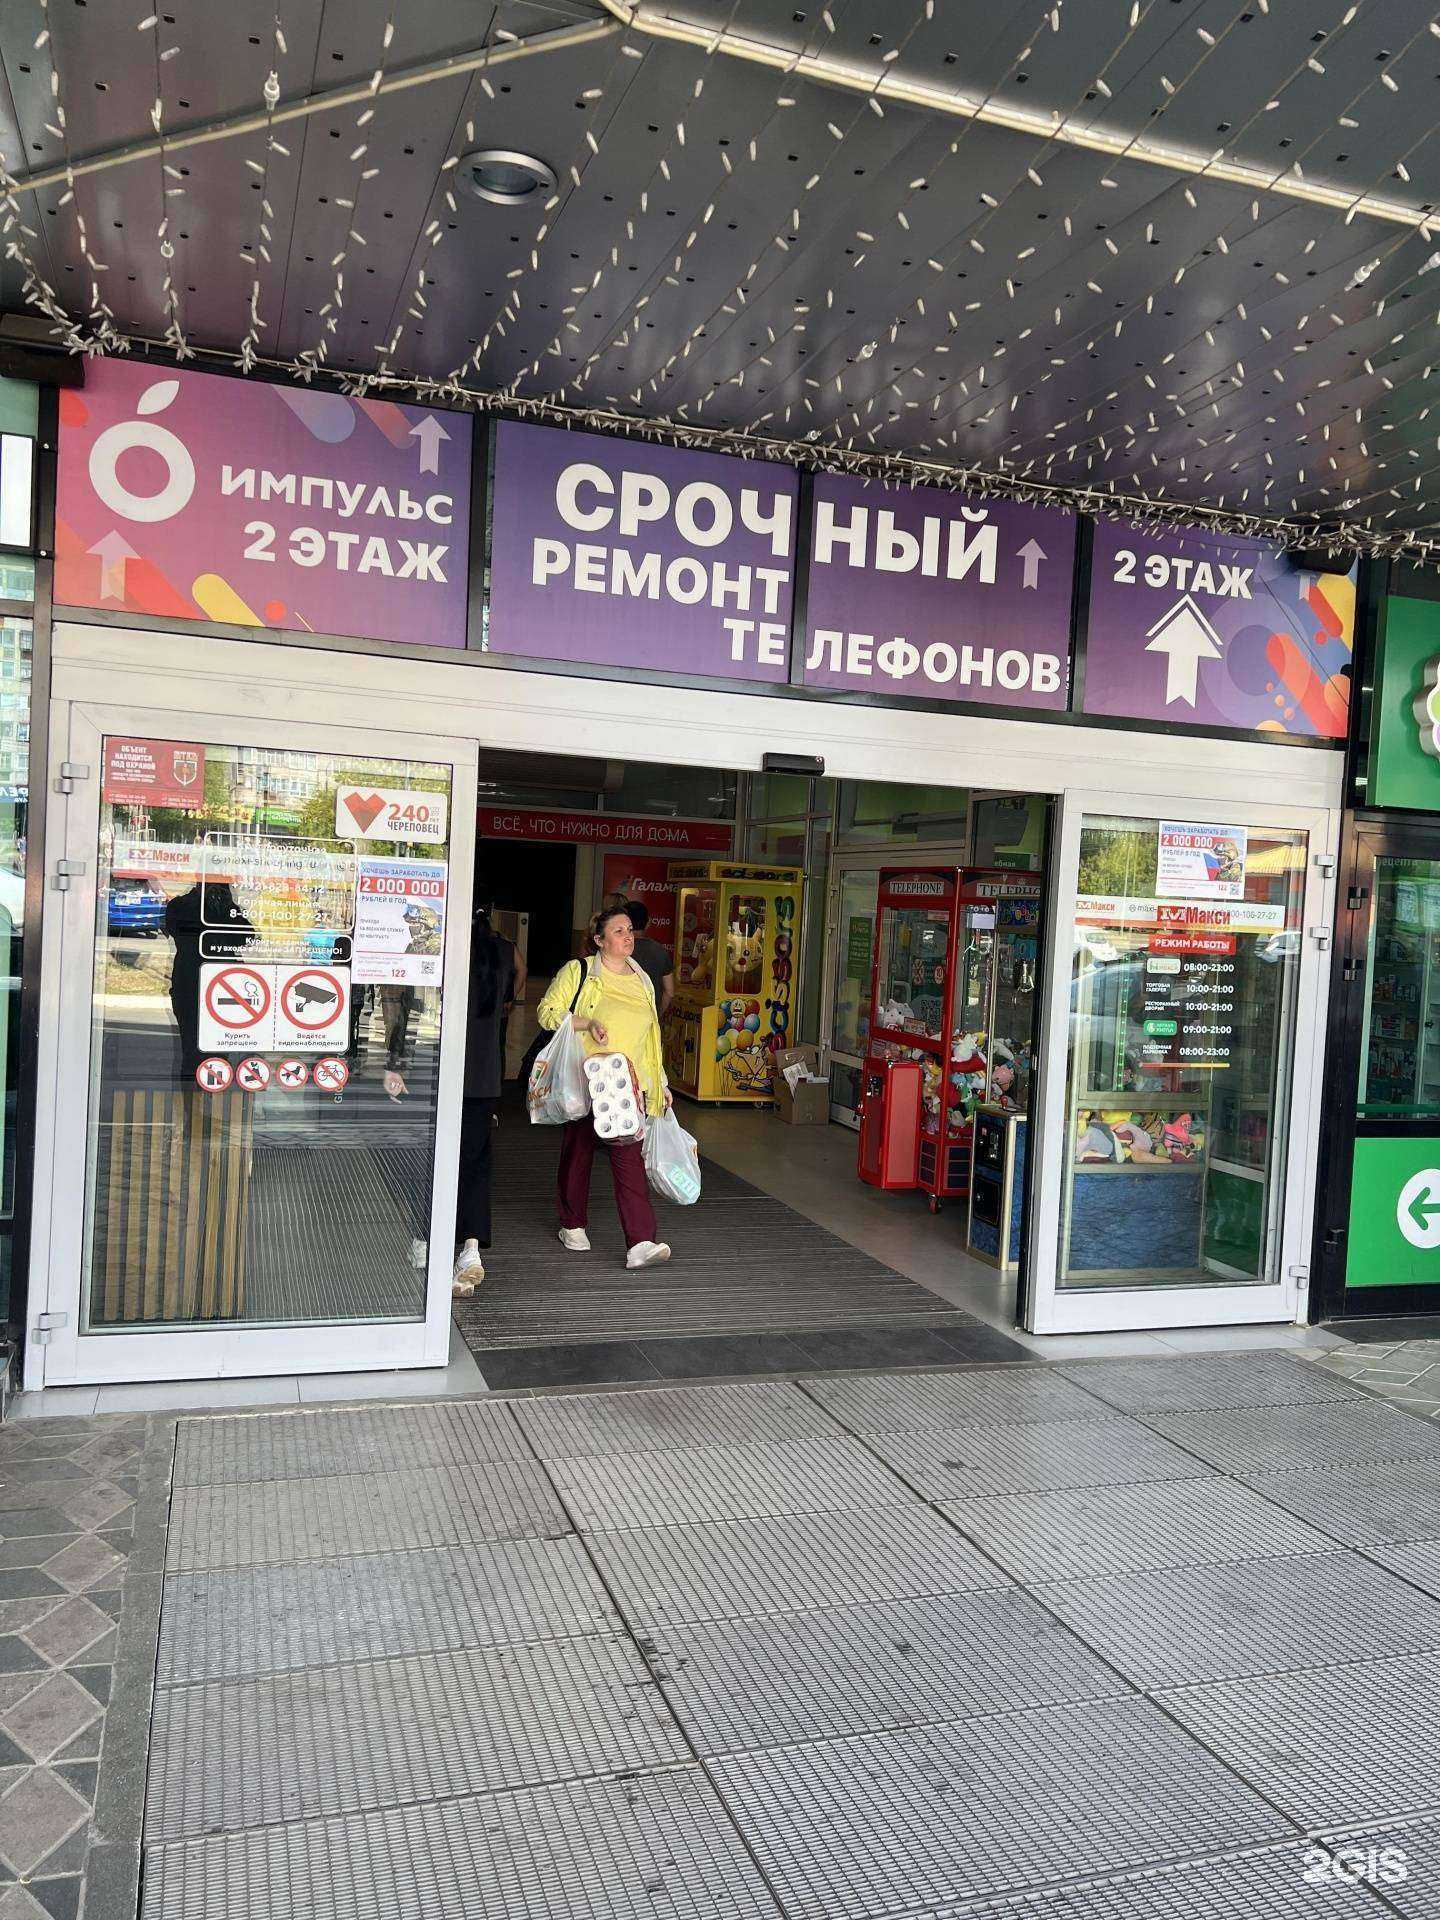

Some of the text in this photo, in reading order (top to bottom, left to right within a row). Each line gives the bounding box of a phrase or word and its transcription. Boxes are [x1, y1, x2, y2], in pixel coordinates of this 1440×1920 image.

[220, 464, 453, 526] ИМПУЛЬС
[555, 462, 792, 557] СРОЧ
[814, 505, 998, 585] НЫЙ
[243, 521, 449, 584] 2 ЭТАЖ
[532, 537, 790, 614] РЕМОНТ
[1113, 549, 1254, 600] 2 ЭТАЖ
[723, 617, 787, 666] ТЕ
[806, 630, 1061, 694] ЛЕФОНОВ
[388, 803, 430, 822] 240
[387, 821, 440, 835] ЧЕРЕПОВЕЦ
[493, 816, 690, 843] ВСЁ, ЧТО НУЖНО ДЛЯ ДОМА
[1163, 835, 1213, 848] 2 000 000
[153, 849, 190, 863] Макси
[391, 869, 430, 877] ЗАРАБОТАТЬ
[362, 877, 440, 896] 2 000 000
[891, 883, 943, 894] TELEPHONE
[1090, 903, 1115, 912] Макси
[1185, 907, 1231, 925] Макси
[1155, 938, 1230, 951] РЕЖИМ РАБОТЫ
[391, 969, 406, 977] 122
[1183, 963, 1235, 973] 08:00-23:00
[1186, 984, 1234, 994] 10:00-21:00
[1185, 1002, 1233, 1012] 10:00-21:00
[1182, 1025, 1232, 1035] 09:00-21:00
[1179, 1048, 1230, 1057] 08:00-23:00
